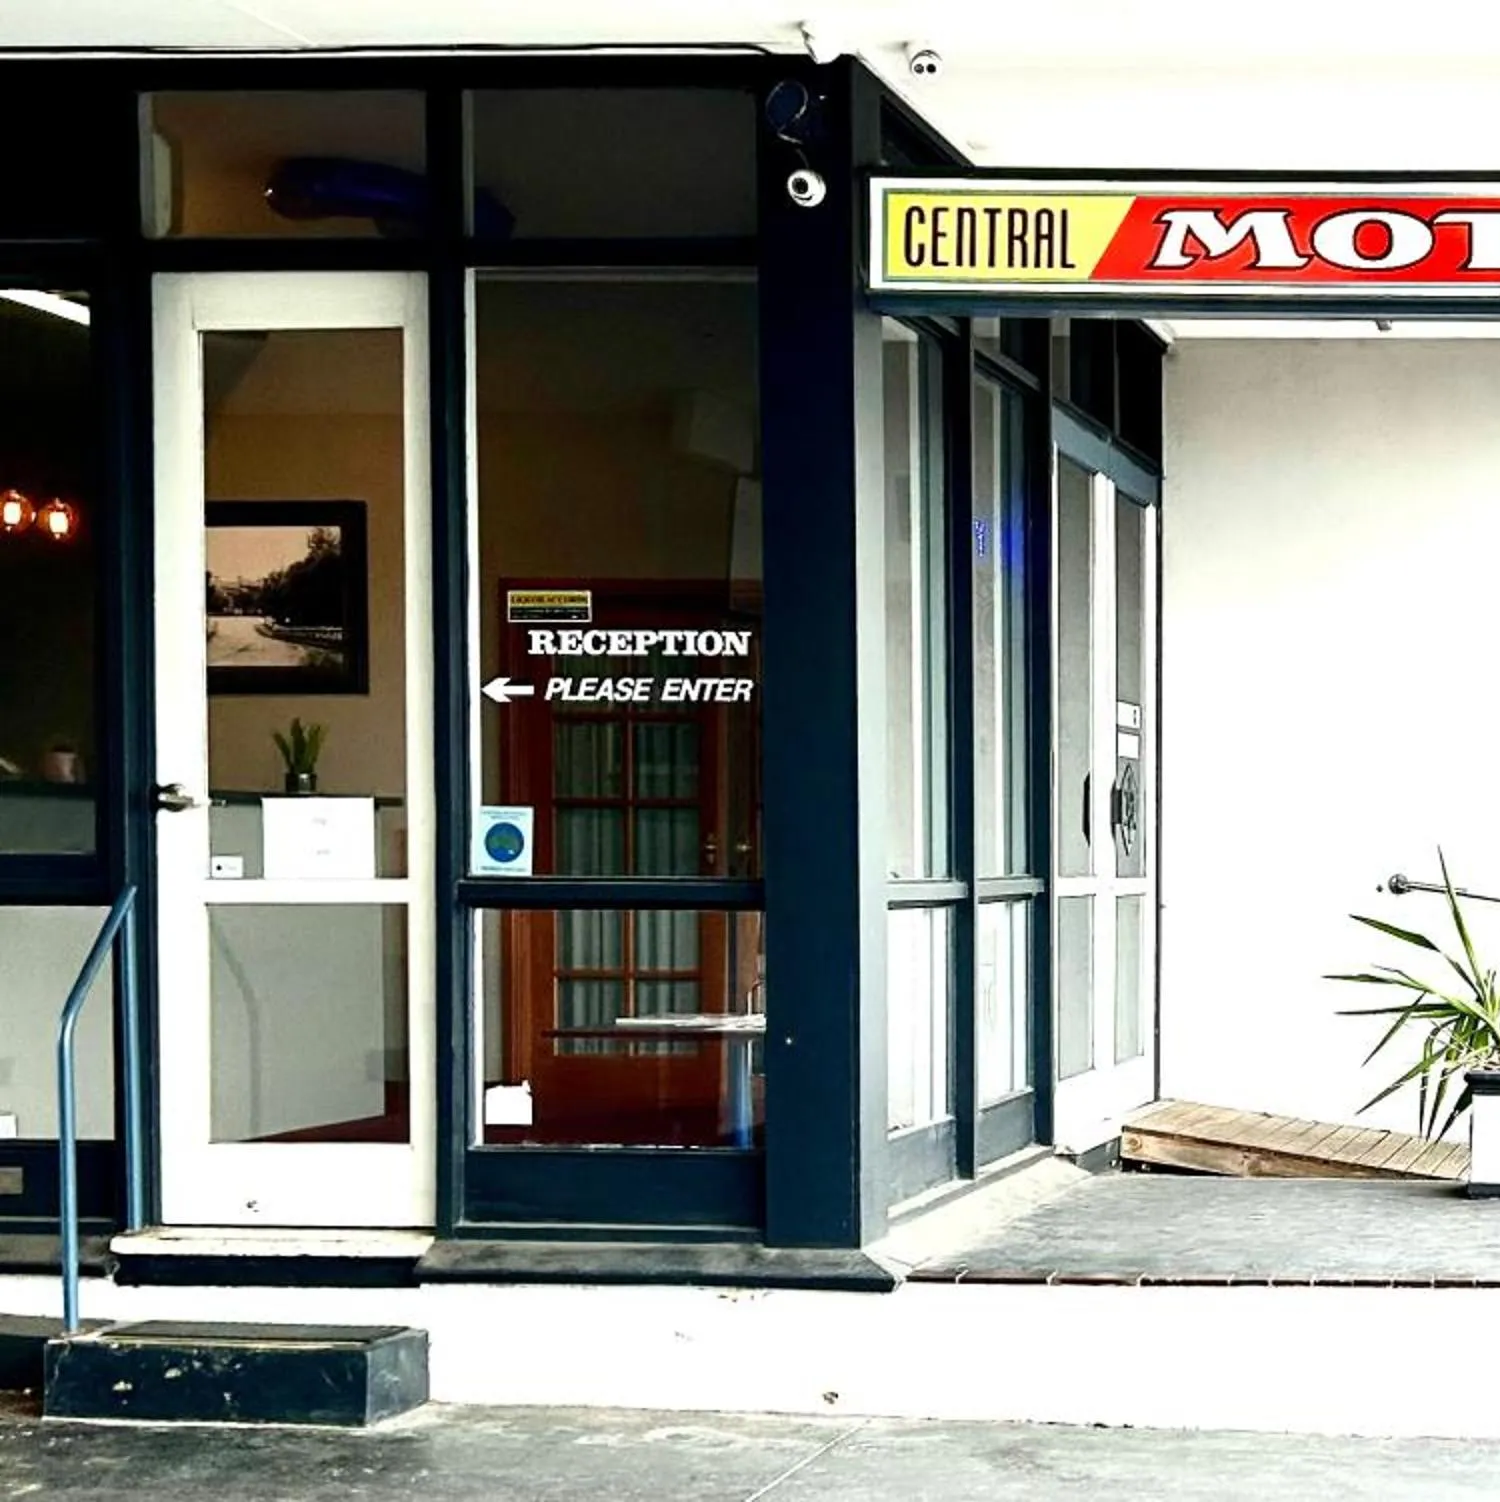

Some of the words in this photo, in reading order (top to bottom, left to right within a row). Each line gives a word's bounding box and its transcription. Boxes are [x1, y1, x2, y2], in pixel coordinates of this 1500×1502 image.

[904, 205, 1076, 269] CENTRAL
[528, 630, 752, 656] RECEPTION
[545, 677, 654, 701] PLEASE
[661, 677, 754, 702] ENTER
